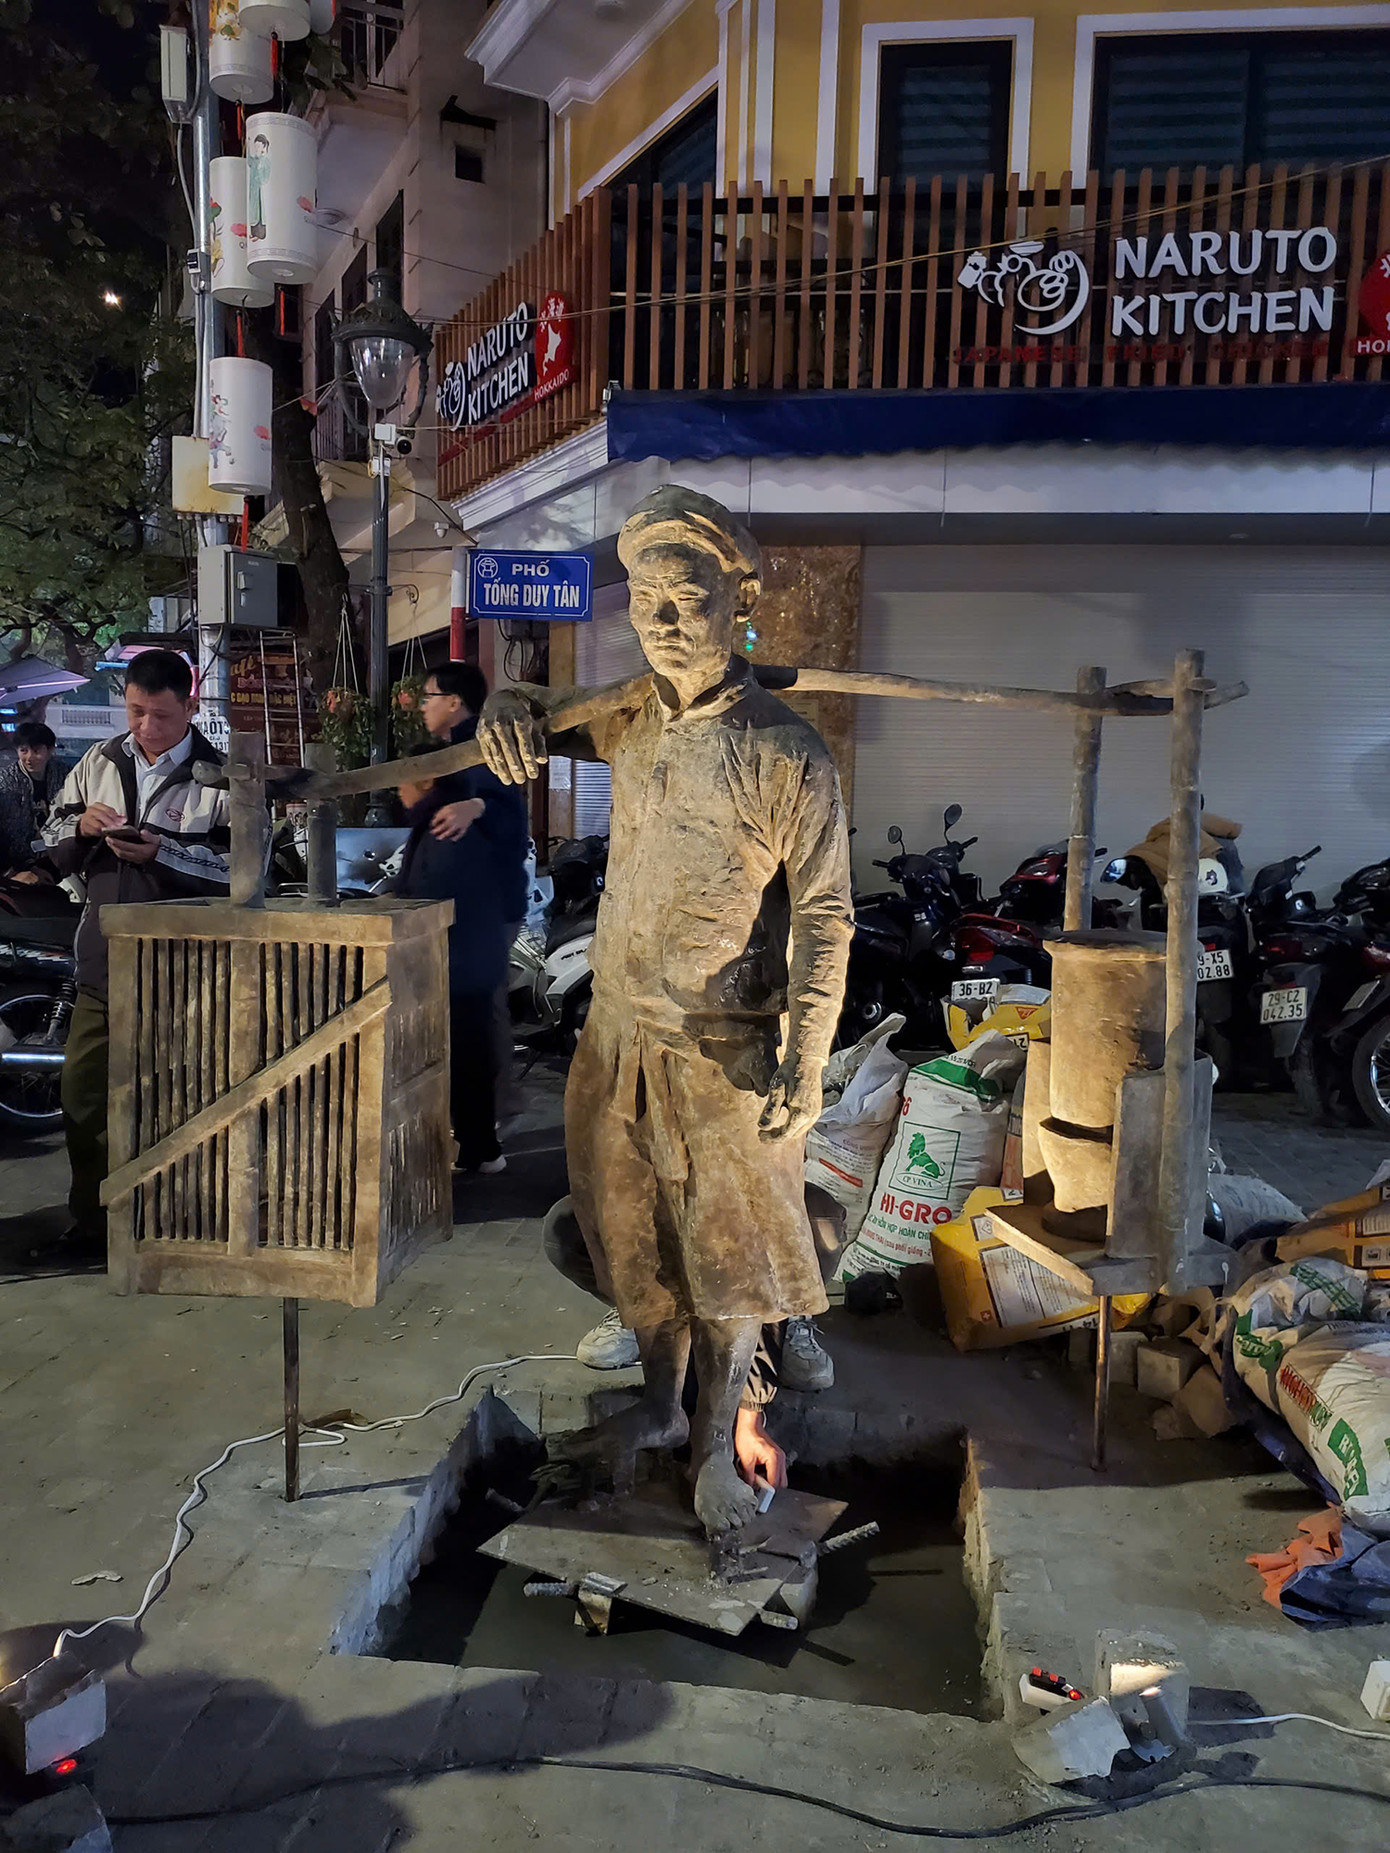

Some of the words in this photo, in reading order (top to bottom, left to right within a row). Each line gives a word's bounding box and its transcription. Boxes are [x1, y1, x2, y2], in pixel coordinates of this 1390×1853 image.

[1114, 226, 1338, 279] NARUTO
[1111, 286, 1335, 336] KITCHEN
[467, 301, 528, 381] NARUTO
[1357, 340, 1390, 353] HO
[468, 352, 528, 425] KITCHEN
[534, 368, 570, 400] HOKKAIDO
[511, 559, 550, 577] PHỐ
[484, 577, 519, 607] TỐNG
[523, 584, 550, 607] DUY
[553, 580, 580, 607] TÂN
[1197, 951, 1224, 966] 9-X5
[1197, 964, 1231, 979] 02.88
[959, 982, 993, 996] 36-B2
[1268, 990, 1300, 1007] 29-C2
[1262, 1003, 1303, 1022] 042.35
[913, 1177, 933, 1188] VINA
[879, 1192, 953, 1225] HI-GRO
